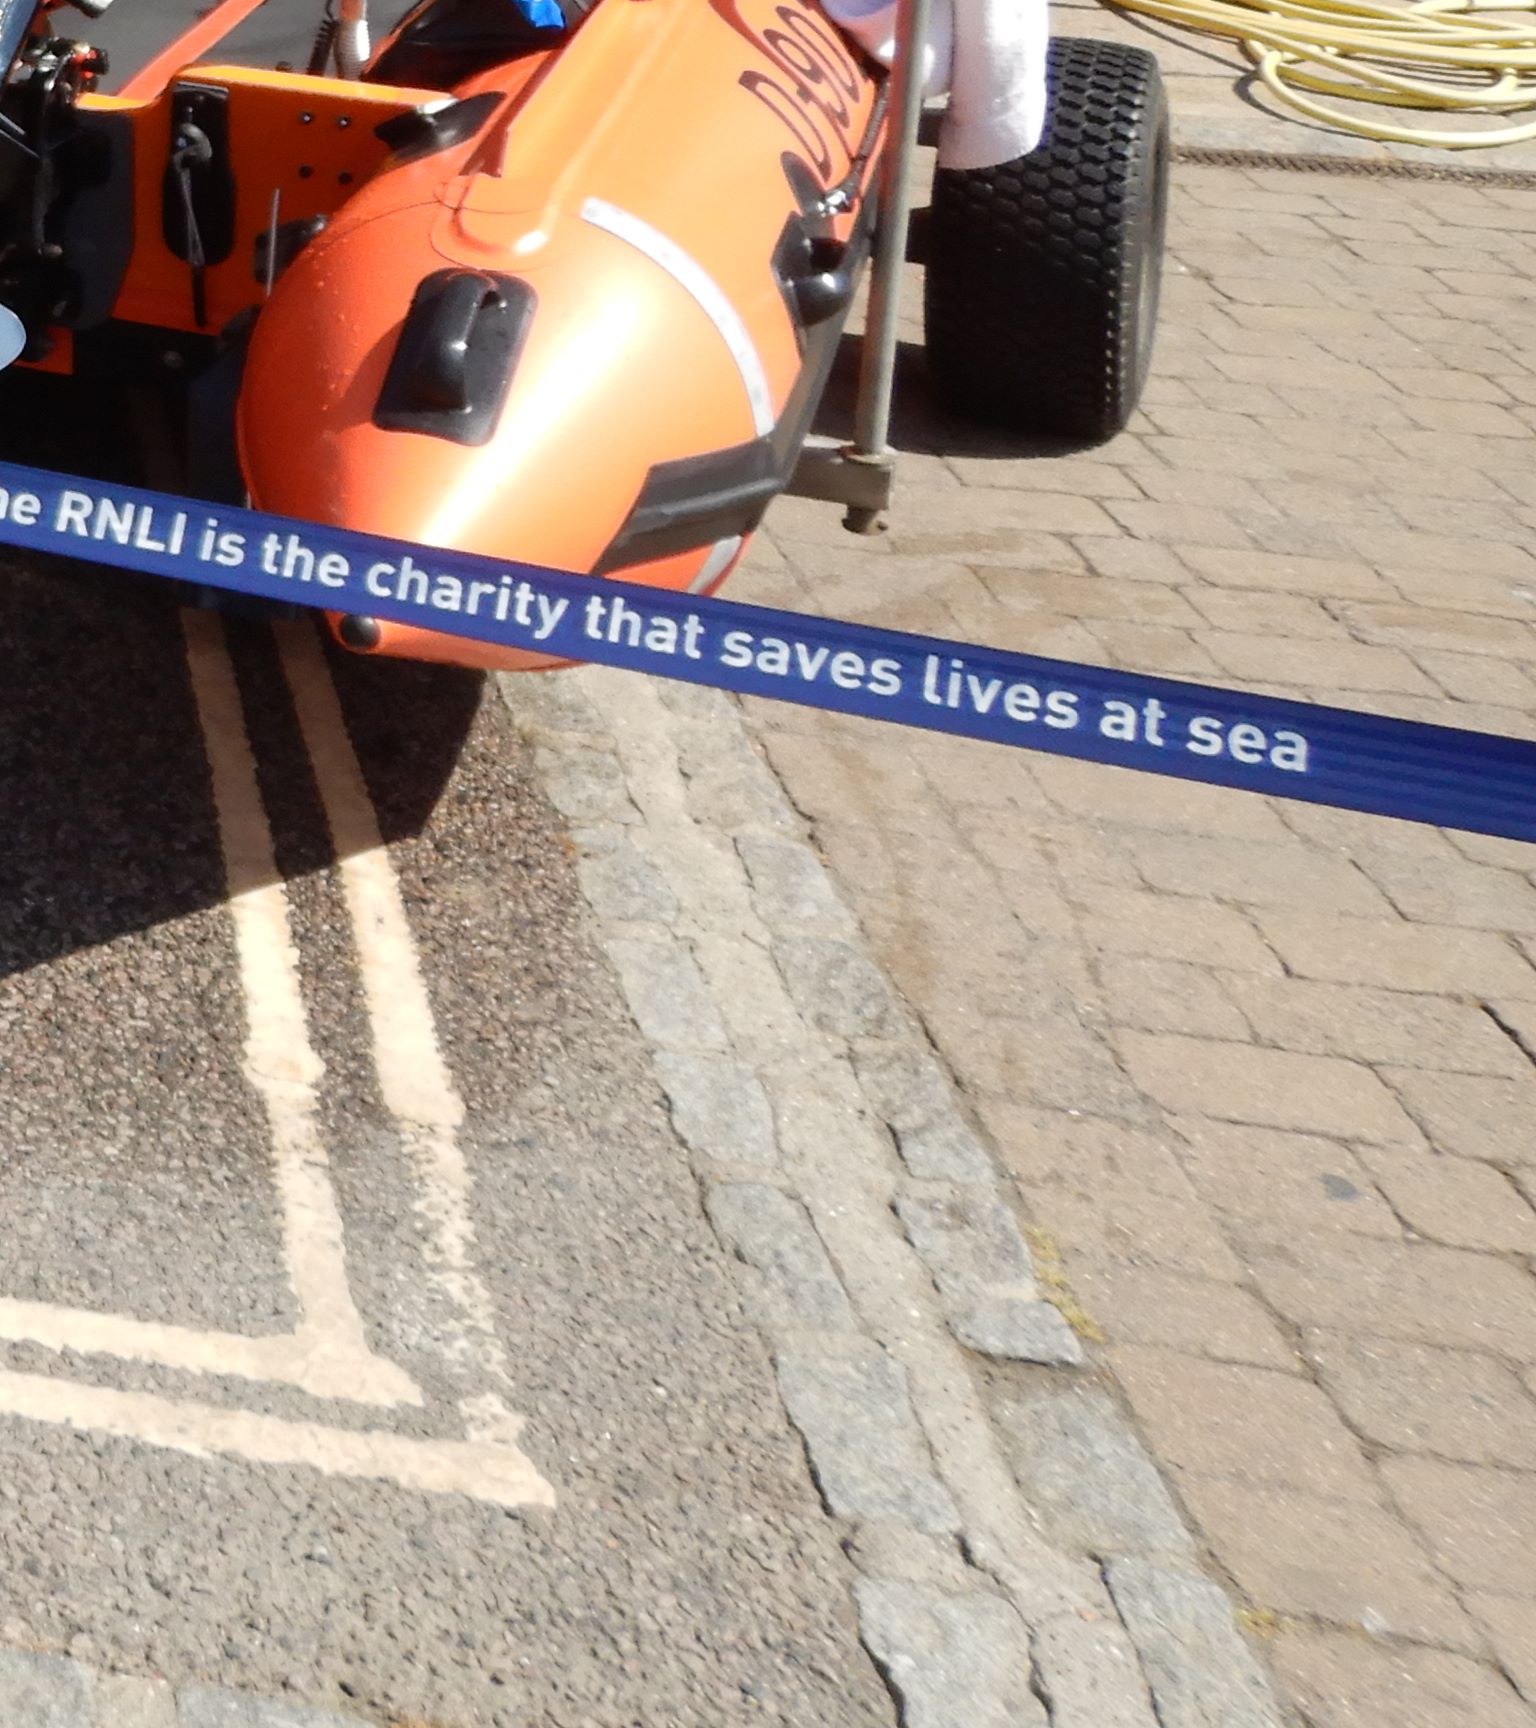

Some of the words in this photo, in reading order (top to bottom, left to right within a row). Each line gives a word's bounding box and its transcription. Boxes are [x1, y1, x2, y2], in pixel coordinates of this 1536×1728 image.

[54, 489, 188, 556] RNLI
[199, 517, 247, 567] is
[261, 532, 351, 588] the
[364, 555, 569, 641] charity
[584, 594, 706, 660] that
[719, 630, 902, 697] saves
[922, 654, 1080, 730] lives
[1099, 698, 1166, 747] at
[1185, 716, 1308, 773] sea
